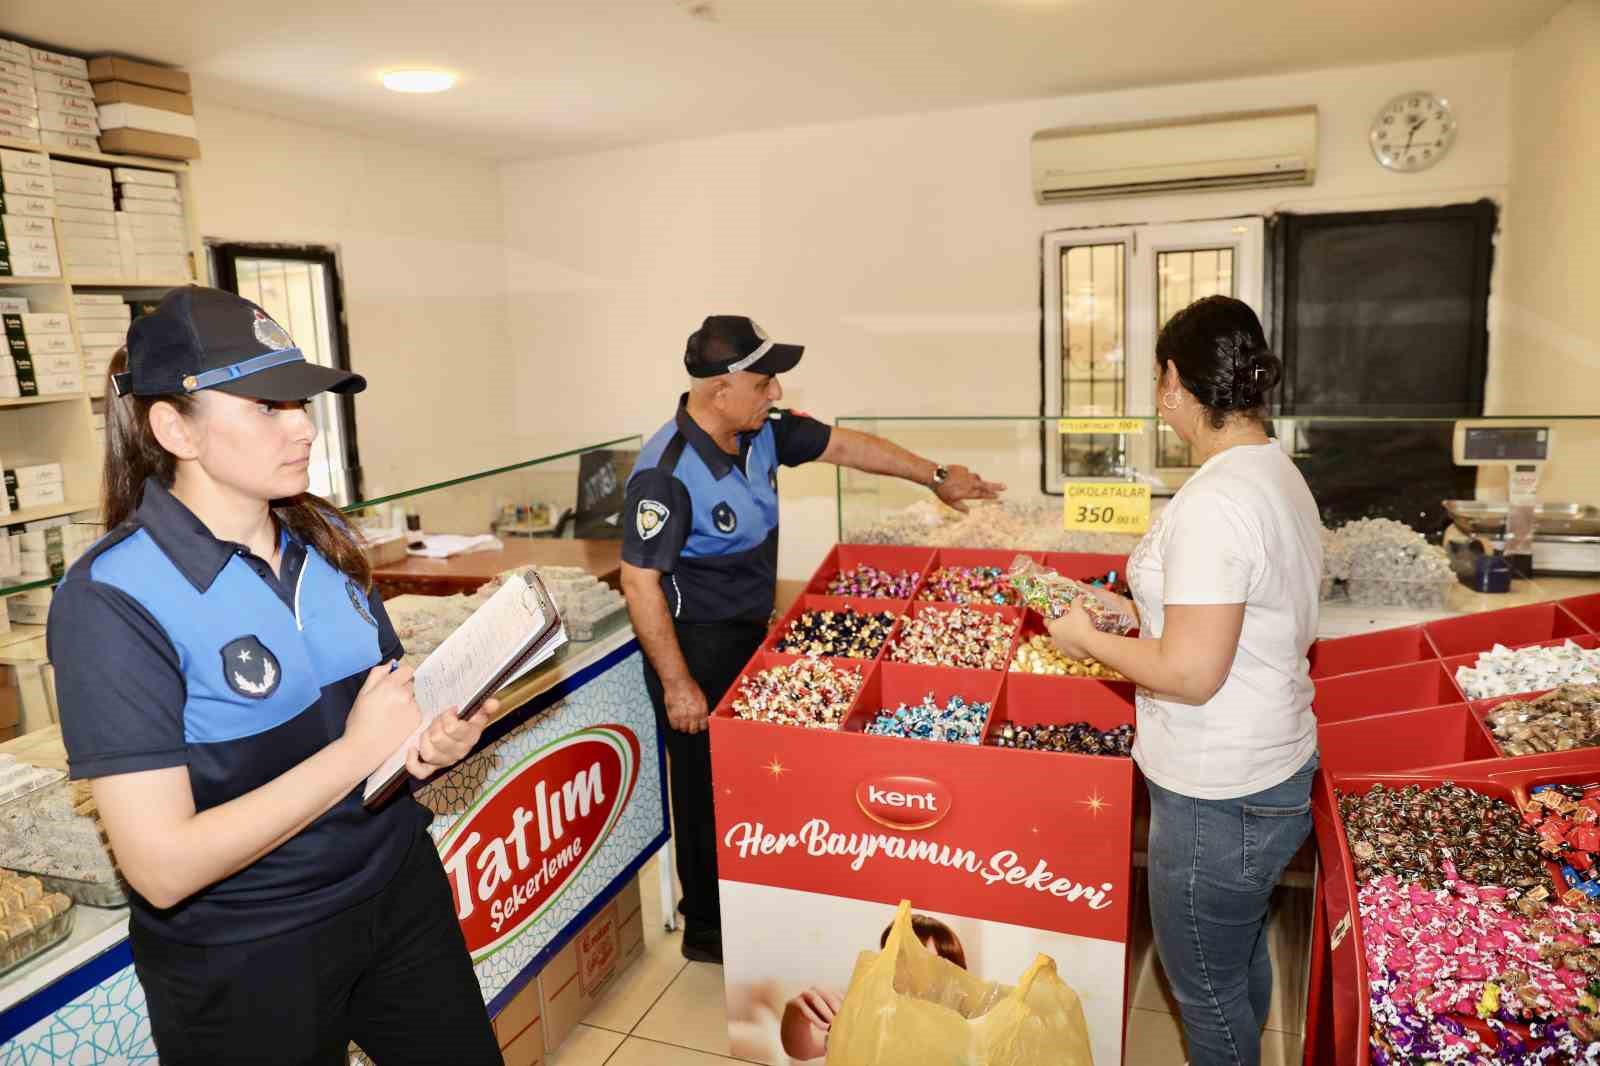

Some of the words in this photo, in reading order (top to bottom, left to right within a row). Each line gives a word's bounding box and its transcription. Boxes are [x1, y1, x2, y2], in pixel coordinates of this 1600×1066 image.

[1075, 506, 1115, 524] 350
[446, 761, 605, 920] Tatlım
[868, 785, 938, 811] kent
[490, 836, 582, 932] Şekerleme
[724, 821, 799, 858] Her
[799, 818, 982, 871] Bayramın
[980, 849, 1113, 910] Şekeri
